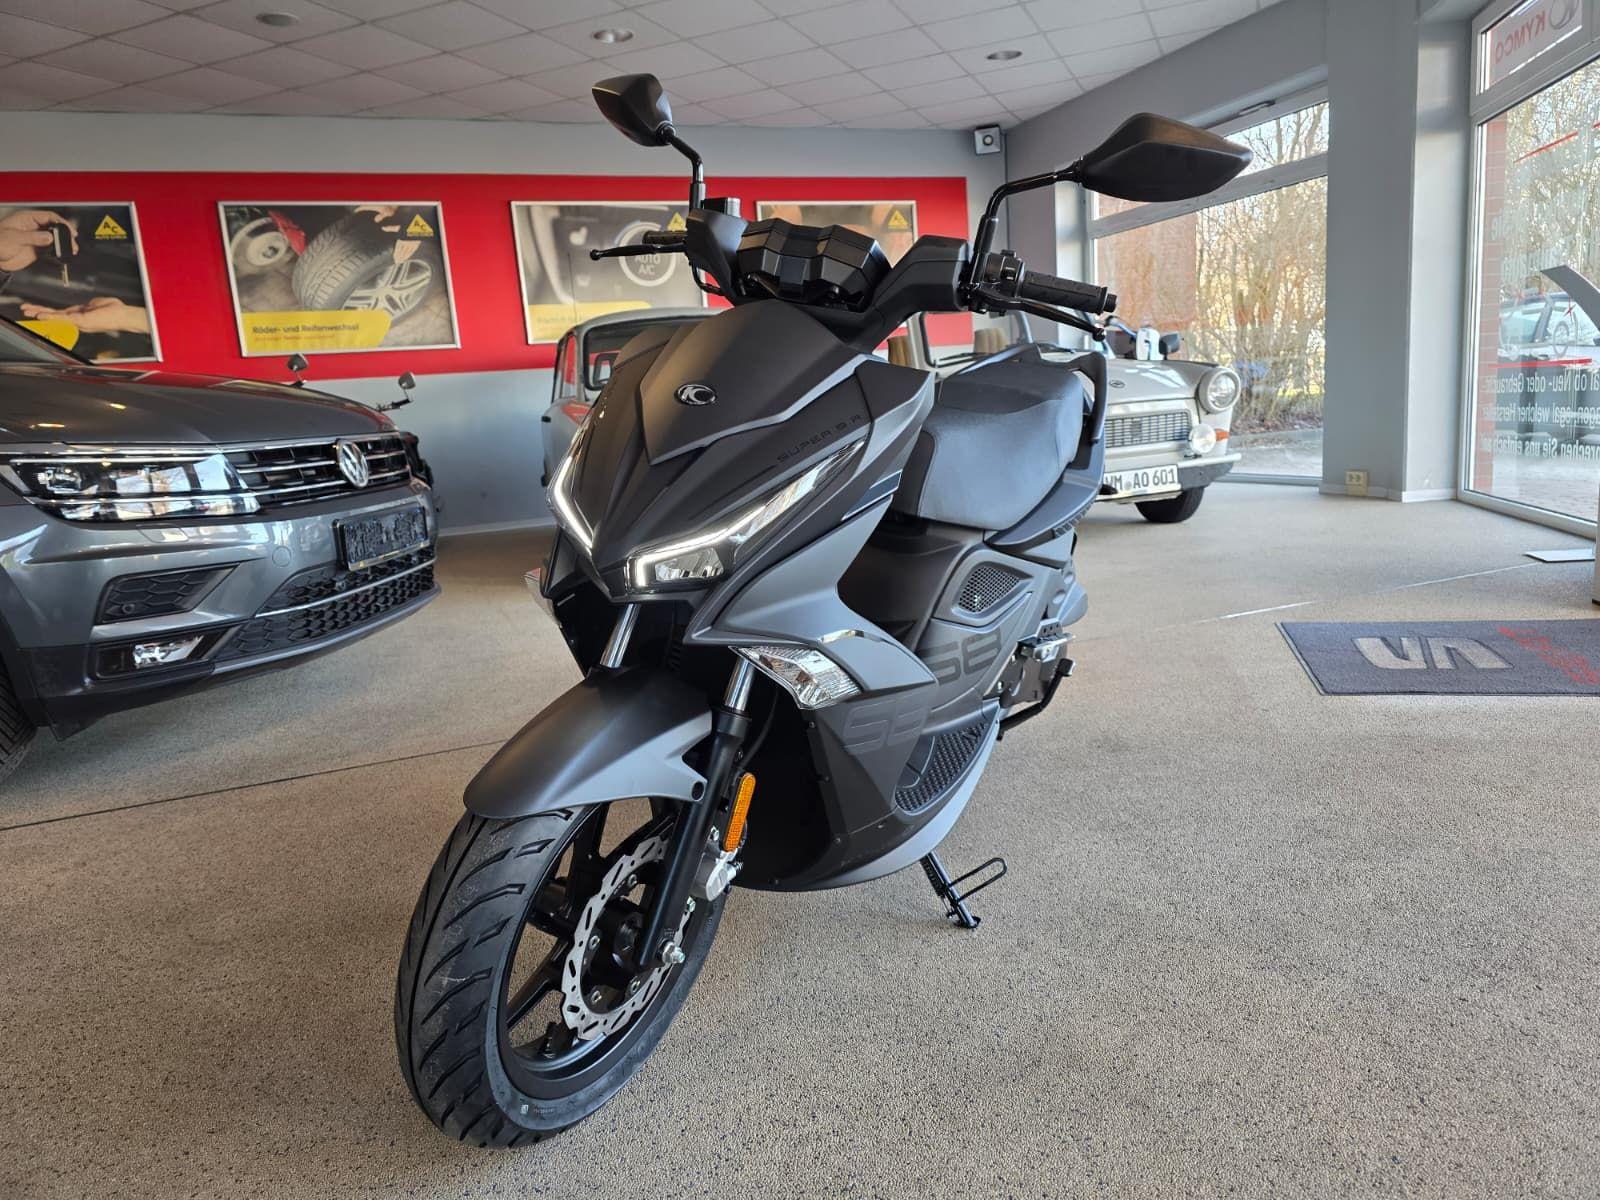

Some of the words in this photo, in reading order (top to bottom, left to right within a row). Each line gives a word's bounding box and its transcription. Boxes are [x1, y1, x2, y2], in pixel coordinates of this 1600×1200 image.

[776, 429, 832, 463] SUPER
[1133, 471, 1149, 489] AO
[1153, 468, 1176, 486] 601
